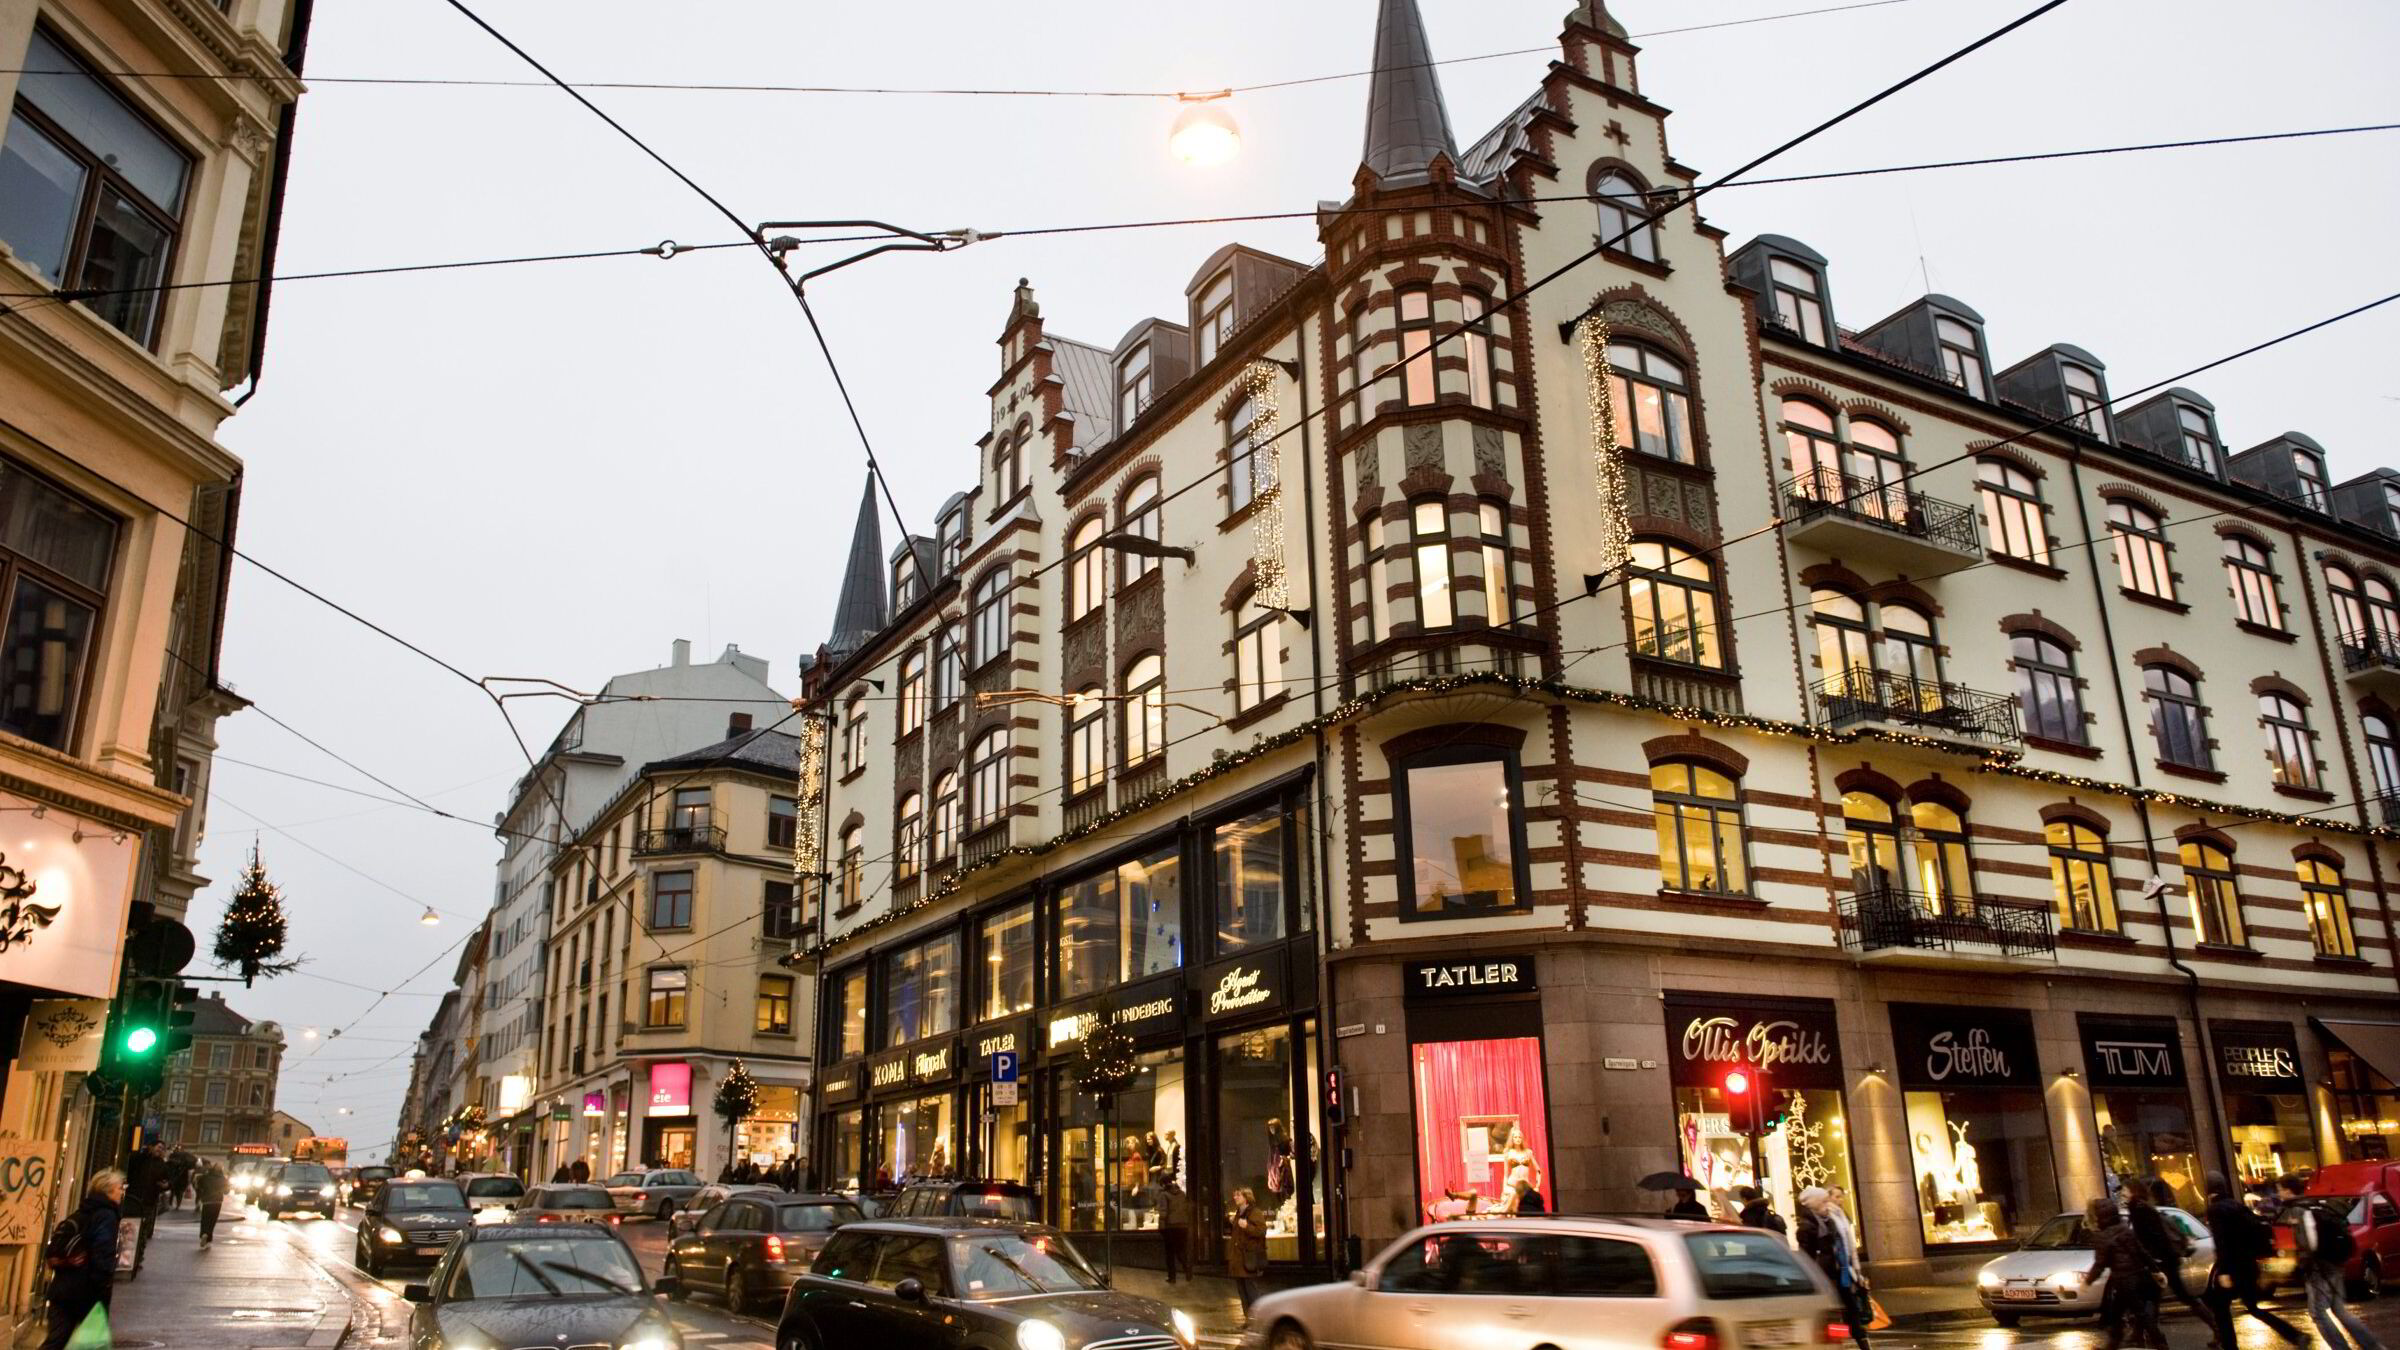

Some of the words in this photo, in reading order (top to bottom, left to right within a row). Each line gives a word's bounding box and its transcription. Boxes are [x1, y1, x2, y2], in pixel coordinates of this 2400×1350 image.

[1220, 967, 1261, 998] Agent
[1420, 963, 1519, 988] TATLER
[1211, 988, 1271, 1014] Provocateur
[979, 1033, 1015, 1057] TATLER
[1683, 1016, 1740, 1063] Ollis
[1746, 1020, 1831, 1070] Optikk
[1927, 1028, 2011, 1081] Steffen
[2223, 1046, 2274, 1063] PEOPLE
[997, 1055, 1011, 1079] P
[2095, 1041, 2172, 1075] TUMI
[2226, 1062, 2277, 1077] COFFEE
[873, 1060, 905, 1087] KOMA
